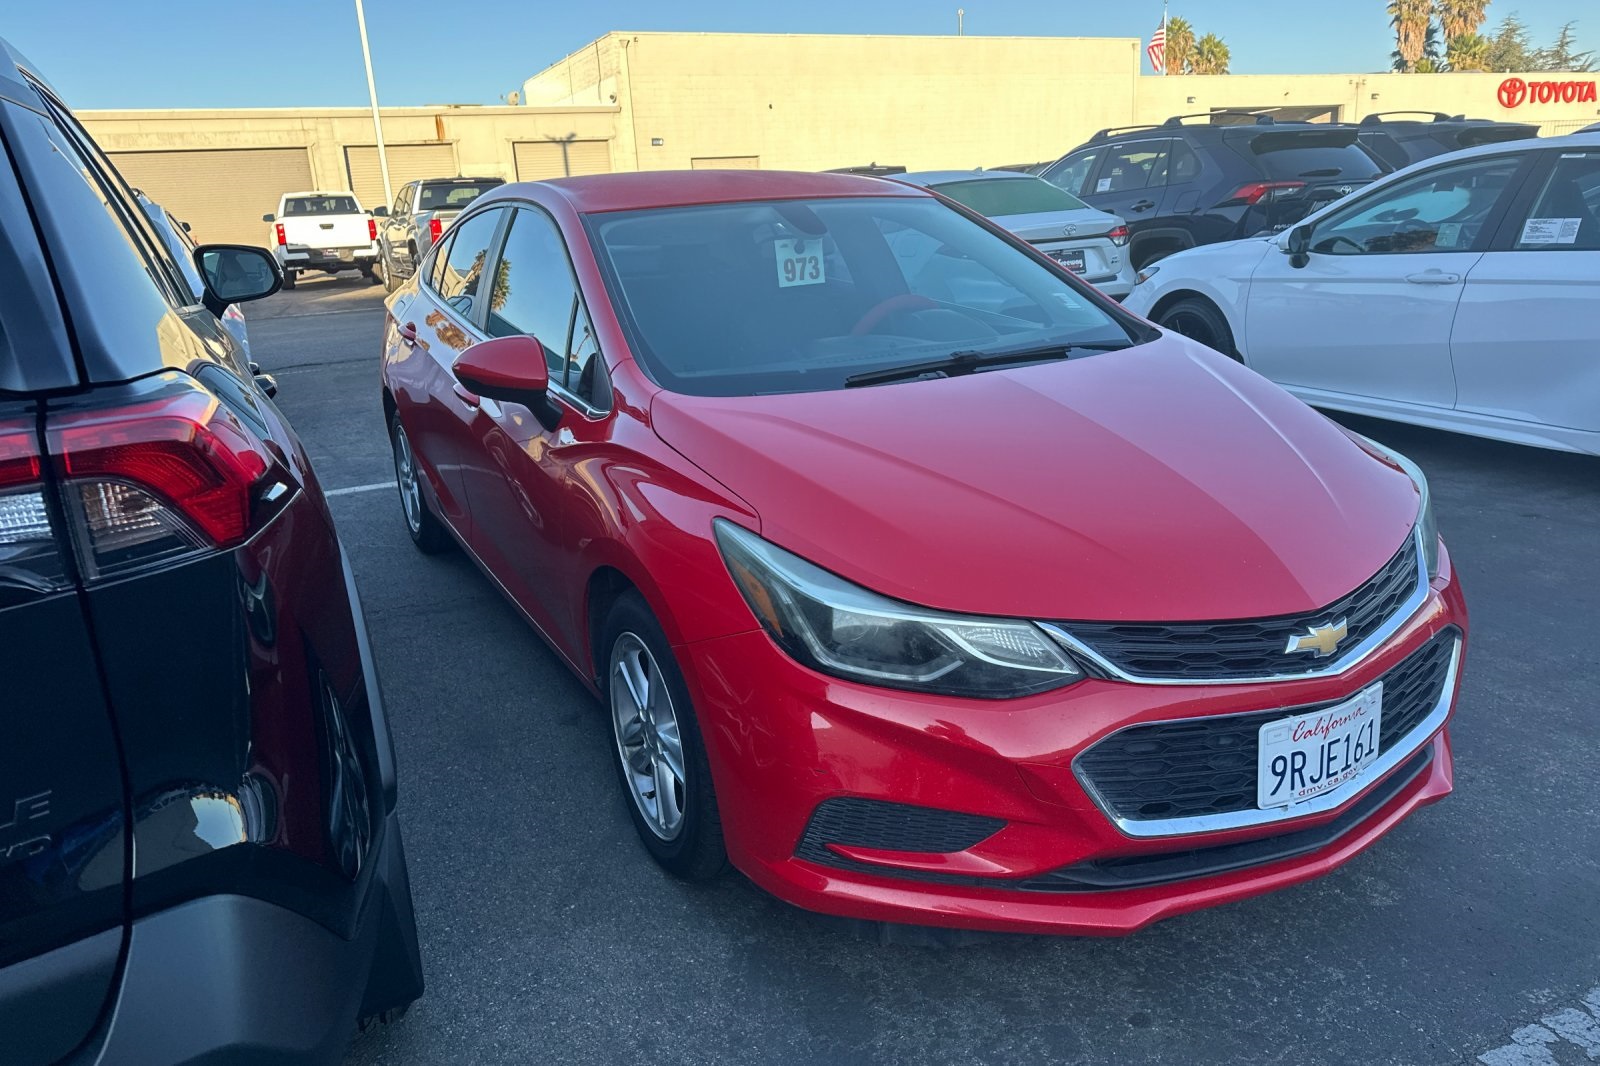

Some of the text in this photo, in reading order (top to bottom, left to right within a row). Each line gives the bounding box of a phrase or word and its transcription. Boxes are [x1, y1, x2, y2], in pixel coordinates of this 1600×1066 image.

[1528, 81, 1597, 104] TOYOTA
[783, 255, 820, 282] 973
[1292, 704, 1367, 742] California
[1270, 717, 1375, 796] 9RJE161
[1298, 766, 1358, 797] dmv.ca.gov
